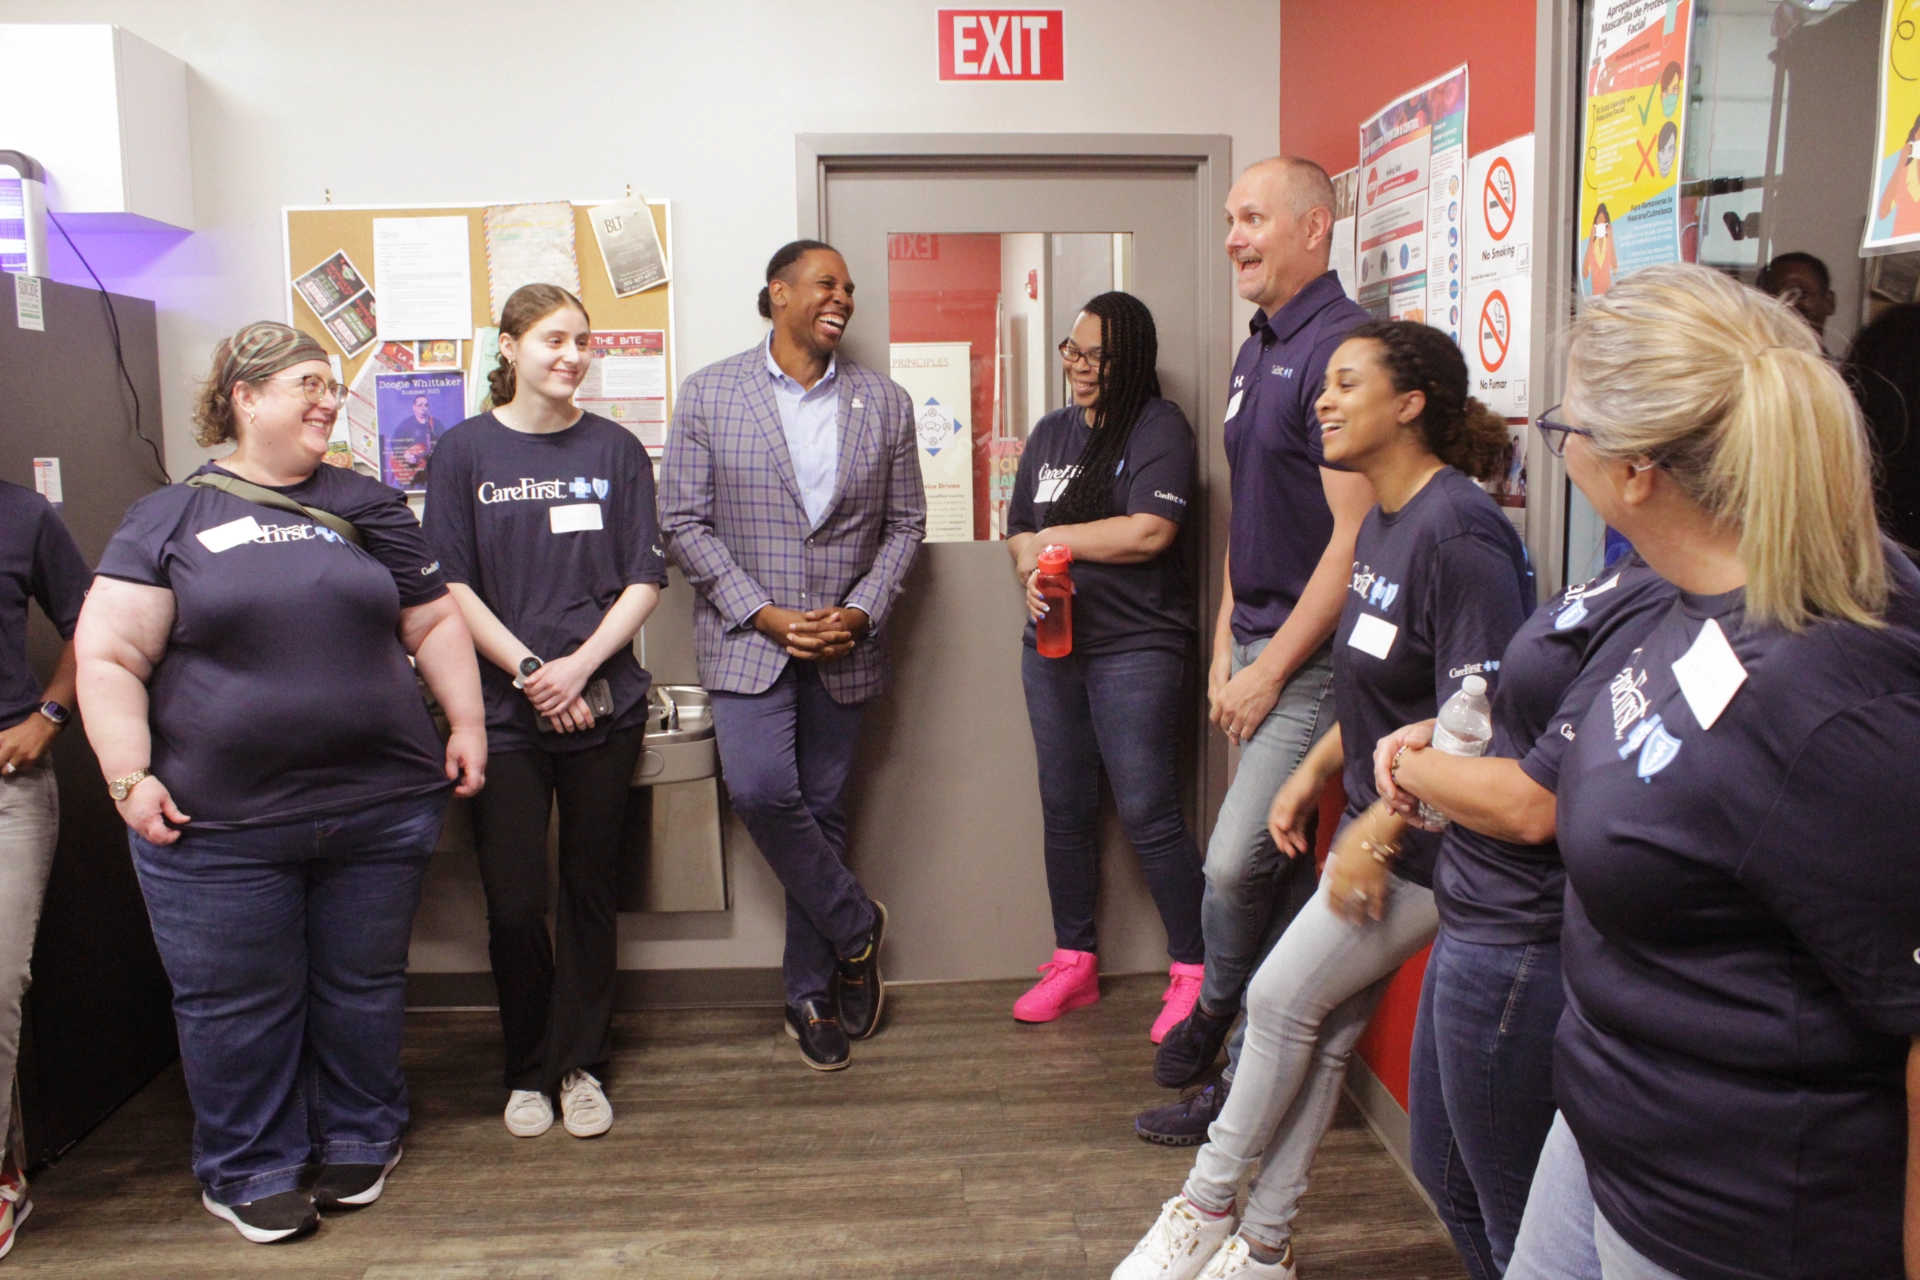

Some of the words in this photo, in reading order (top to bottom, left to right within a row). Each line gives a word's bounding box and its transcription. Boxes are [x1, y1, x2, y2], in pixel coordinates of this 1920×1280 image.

[1601, 11, 1632, 34] Mascarilla
[1634, 6, 1642, 18] de
[1627, 16, 1646, 36] Facial
[953, 15, 1048, 75] EXIT
[1615, 42, 1650, 62] Primeramente
[1631, 203, 1641, 212] Para
[1642, 198, 1666, 210] Removerse
[1627, 206, 1672, 223] Mascara/Cubreboca
[604, 216, 622, 234] BLT
[1482, 250, 1490, 261] No
[1492, 244, 1515, 259] Smoking
[594, 336, 614, 345] THE
[620, 336, 642, 344] BITE
[893, 358, 949, 367] PRINCIPLES
[380, 380, 410, 390] Doogie
[412, 378, 462, 388] Whittaker
[1480, 379, 1488, 390] No
[1489, 378, 1507, 390] Fumar
[988, 440, 1026, 456] WAS
[990, 475, 1016, 488] HAN
[478, 478, 566, 504] CareFirst
[990, 489, 1012, 500] PLE
[1449, 662, 1484, 678] CareFirst
